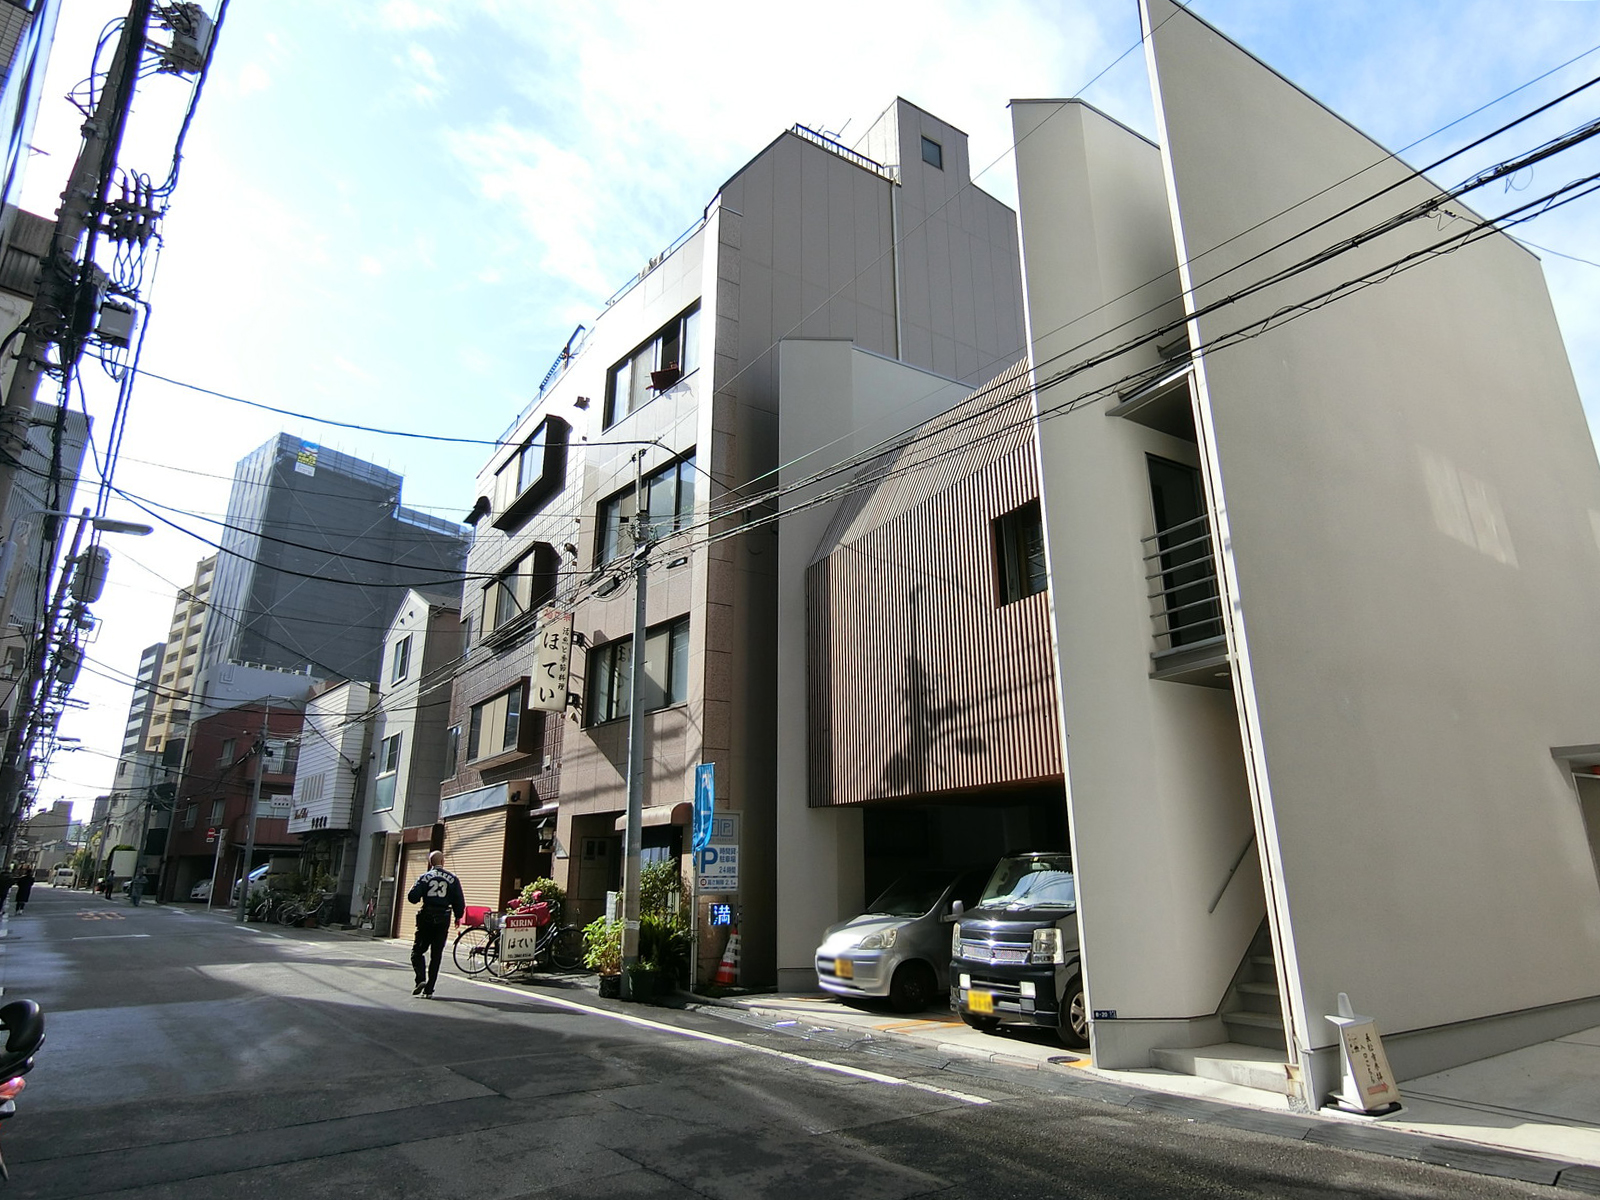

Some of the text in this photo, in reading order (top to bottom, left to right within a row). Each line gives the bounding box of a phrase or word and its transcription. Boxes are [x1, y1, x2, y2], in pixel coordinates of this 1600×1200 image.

[557, 626, 570, 691] 活魚と季節料理
[539, 632, 560, 703] ほてい
[719, 847, 736, 855] 時間貸
[719, 855, 736, 863] 駐車場
[700, 847, 718, 874] P
[718, 866, 736, 874] 24時間
[427, 879, 448, 898] 23
[510, 918, 534, 927] KIRIN
[713, 904, 731, 925] 満
[507, 937, 533, 950] ほてい
